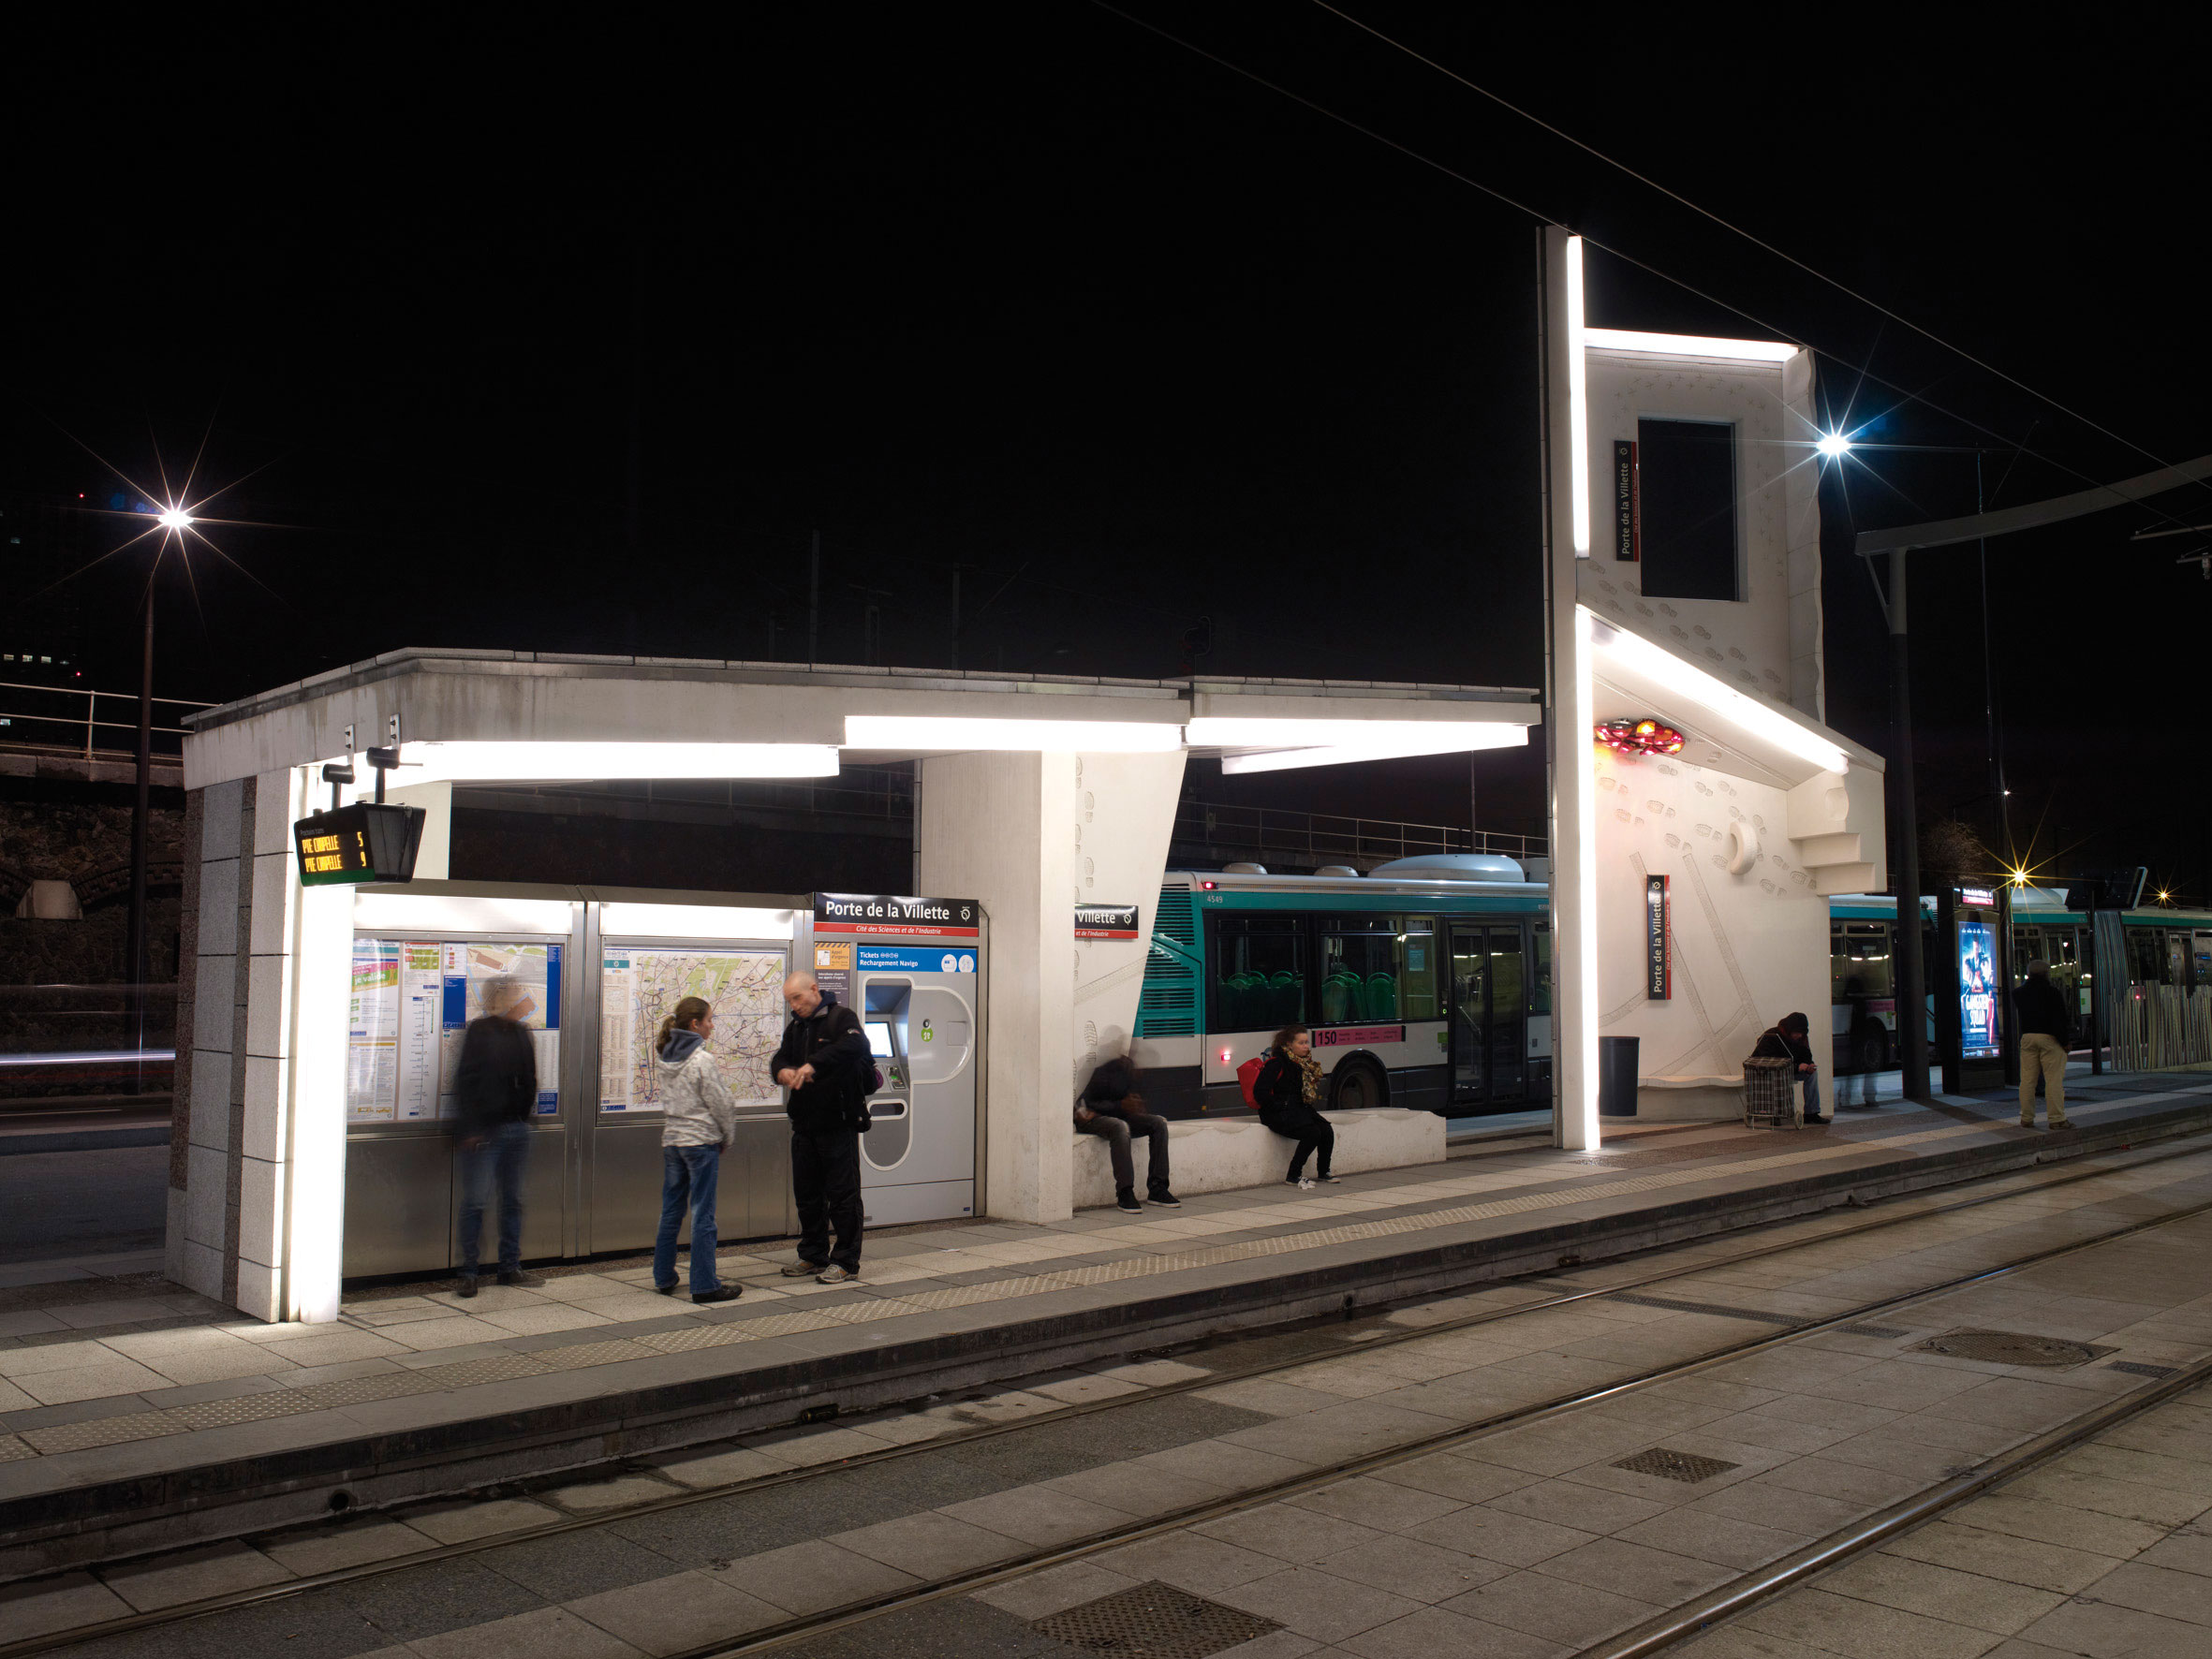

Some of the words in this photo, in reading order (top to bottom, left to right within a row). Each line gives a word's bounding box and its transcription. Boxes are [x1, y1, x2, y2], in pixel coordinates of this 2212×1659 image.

[1620, 462, 1629, 499] Villette
[1621, 501, 1629, 510] la
[1621, 512, 1630, 525] de
[1621, 529, 1630, 554] Porte
[357, 831, 363, 846] 5
[360, 851, 366, 867] 9
[826, 901, 863, 917] Porte
[866, 902, 884, 918] de
[887, 903, 899, 918] la
[903, 904, 950, 920] Villette
[1077, 911, 1116, 924] Villette
[1652, 896, 1662, 934] Villette
[1652, 937, 1662, 947] la
[1653, 949, 1662, 962] de
[860, 960, 898, 968] Rechargement
[1653, 964, 1662, 992] Porte
[1318, 1031, 1337, 1045] 150
